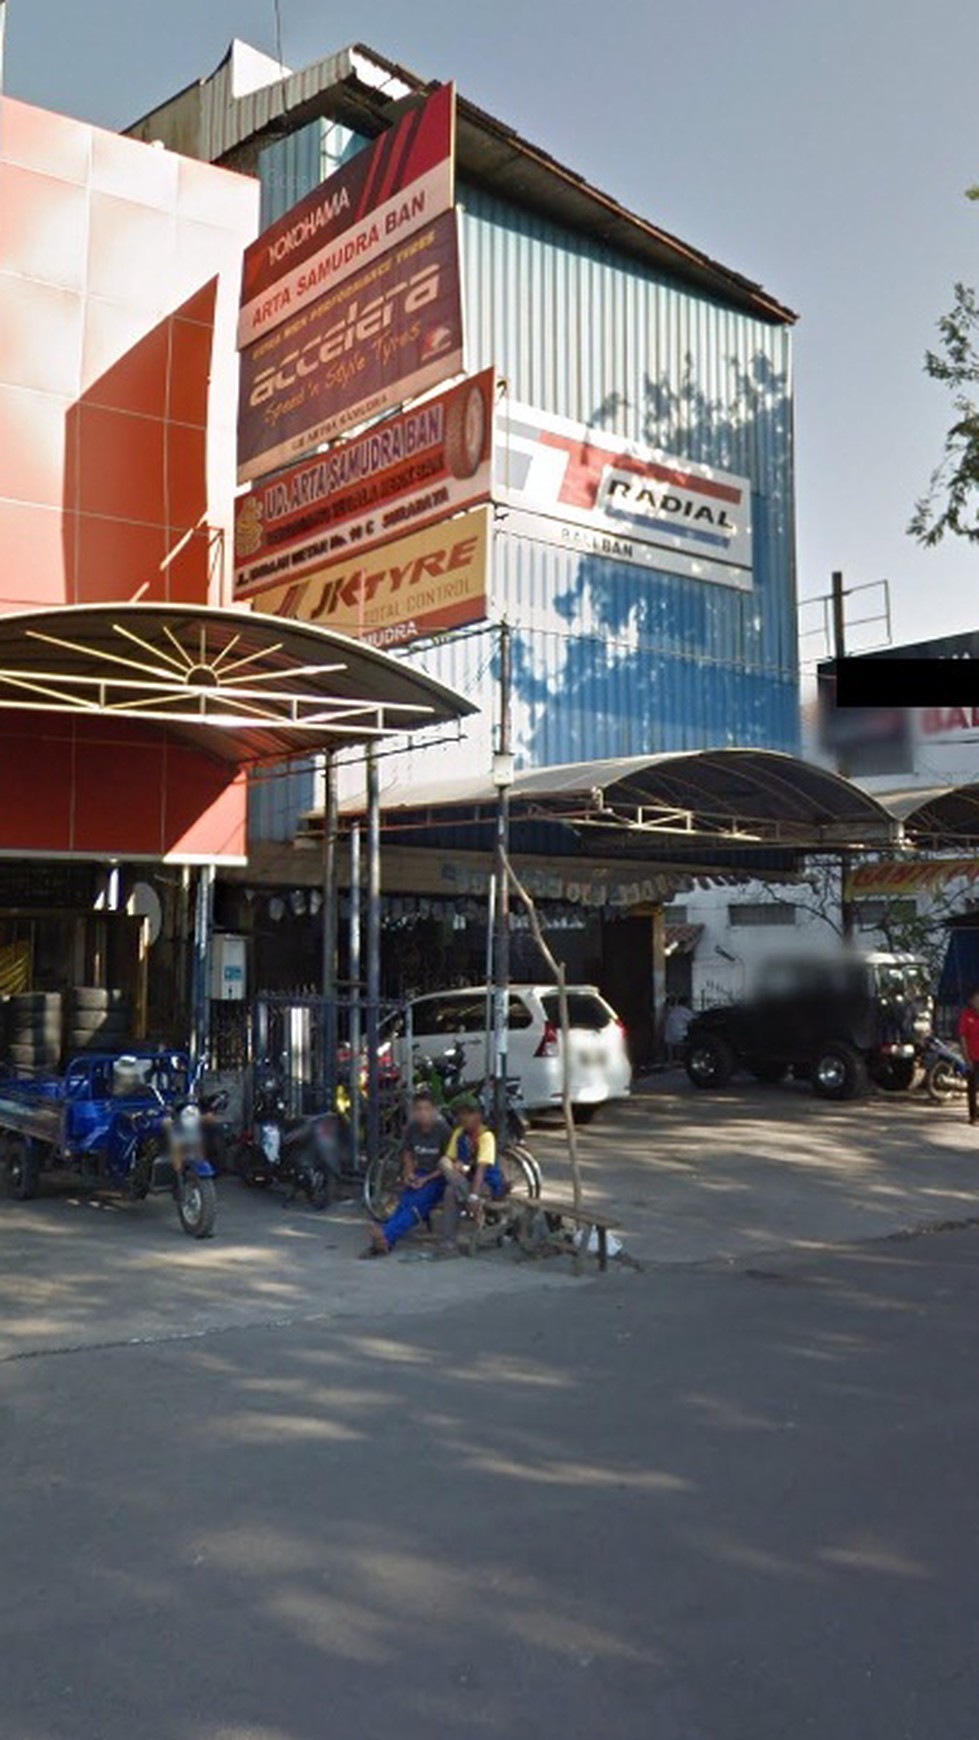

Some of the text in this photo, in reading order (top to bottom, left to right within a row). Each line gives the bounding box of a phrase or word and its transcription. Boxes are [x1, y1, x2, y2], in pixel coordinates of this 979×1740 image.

[251, 191, 426, 328] ARTA SAMUDRA BAN
[268, 186, 350, 267] YOKOHAMA
[250, 264, 440, 407] accelera
[264, 388, 305, 426] Speed
[324, 355, 366, 389] Style
[372, 320, 421, 365] Tyres
[328, 422, 402, 494] SAMUDRA
[404, 403, 444, 458] BAN
[606, 478, 735, 530] RADIAL
